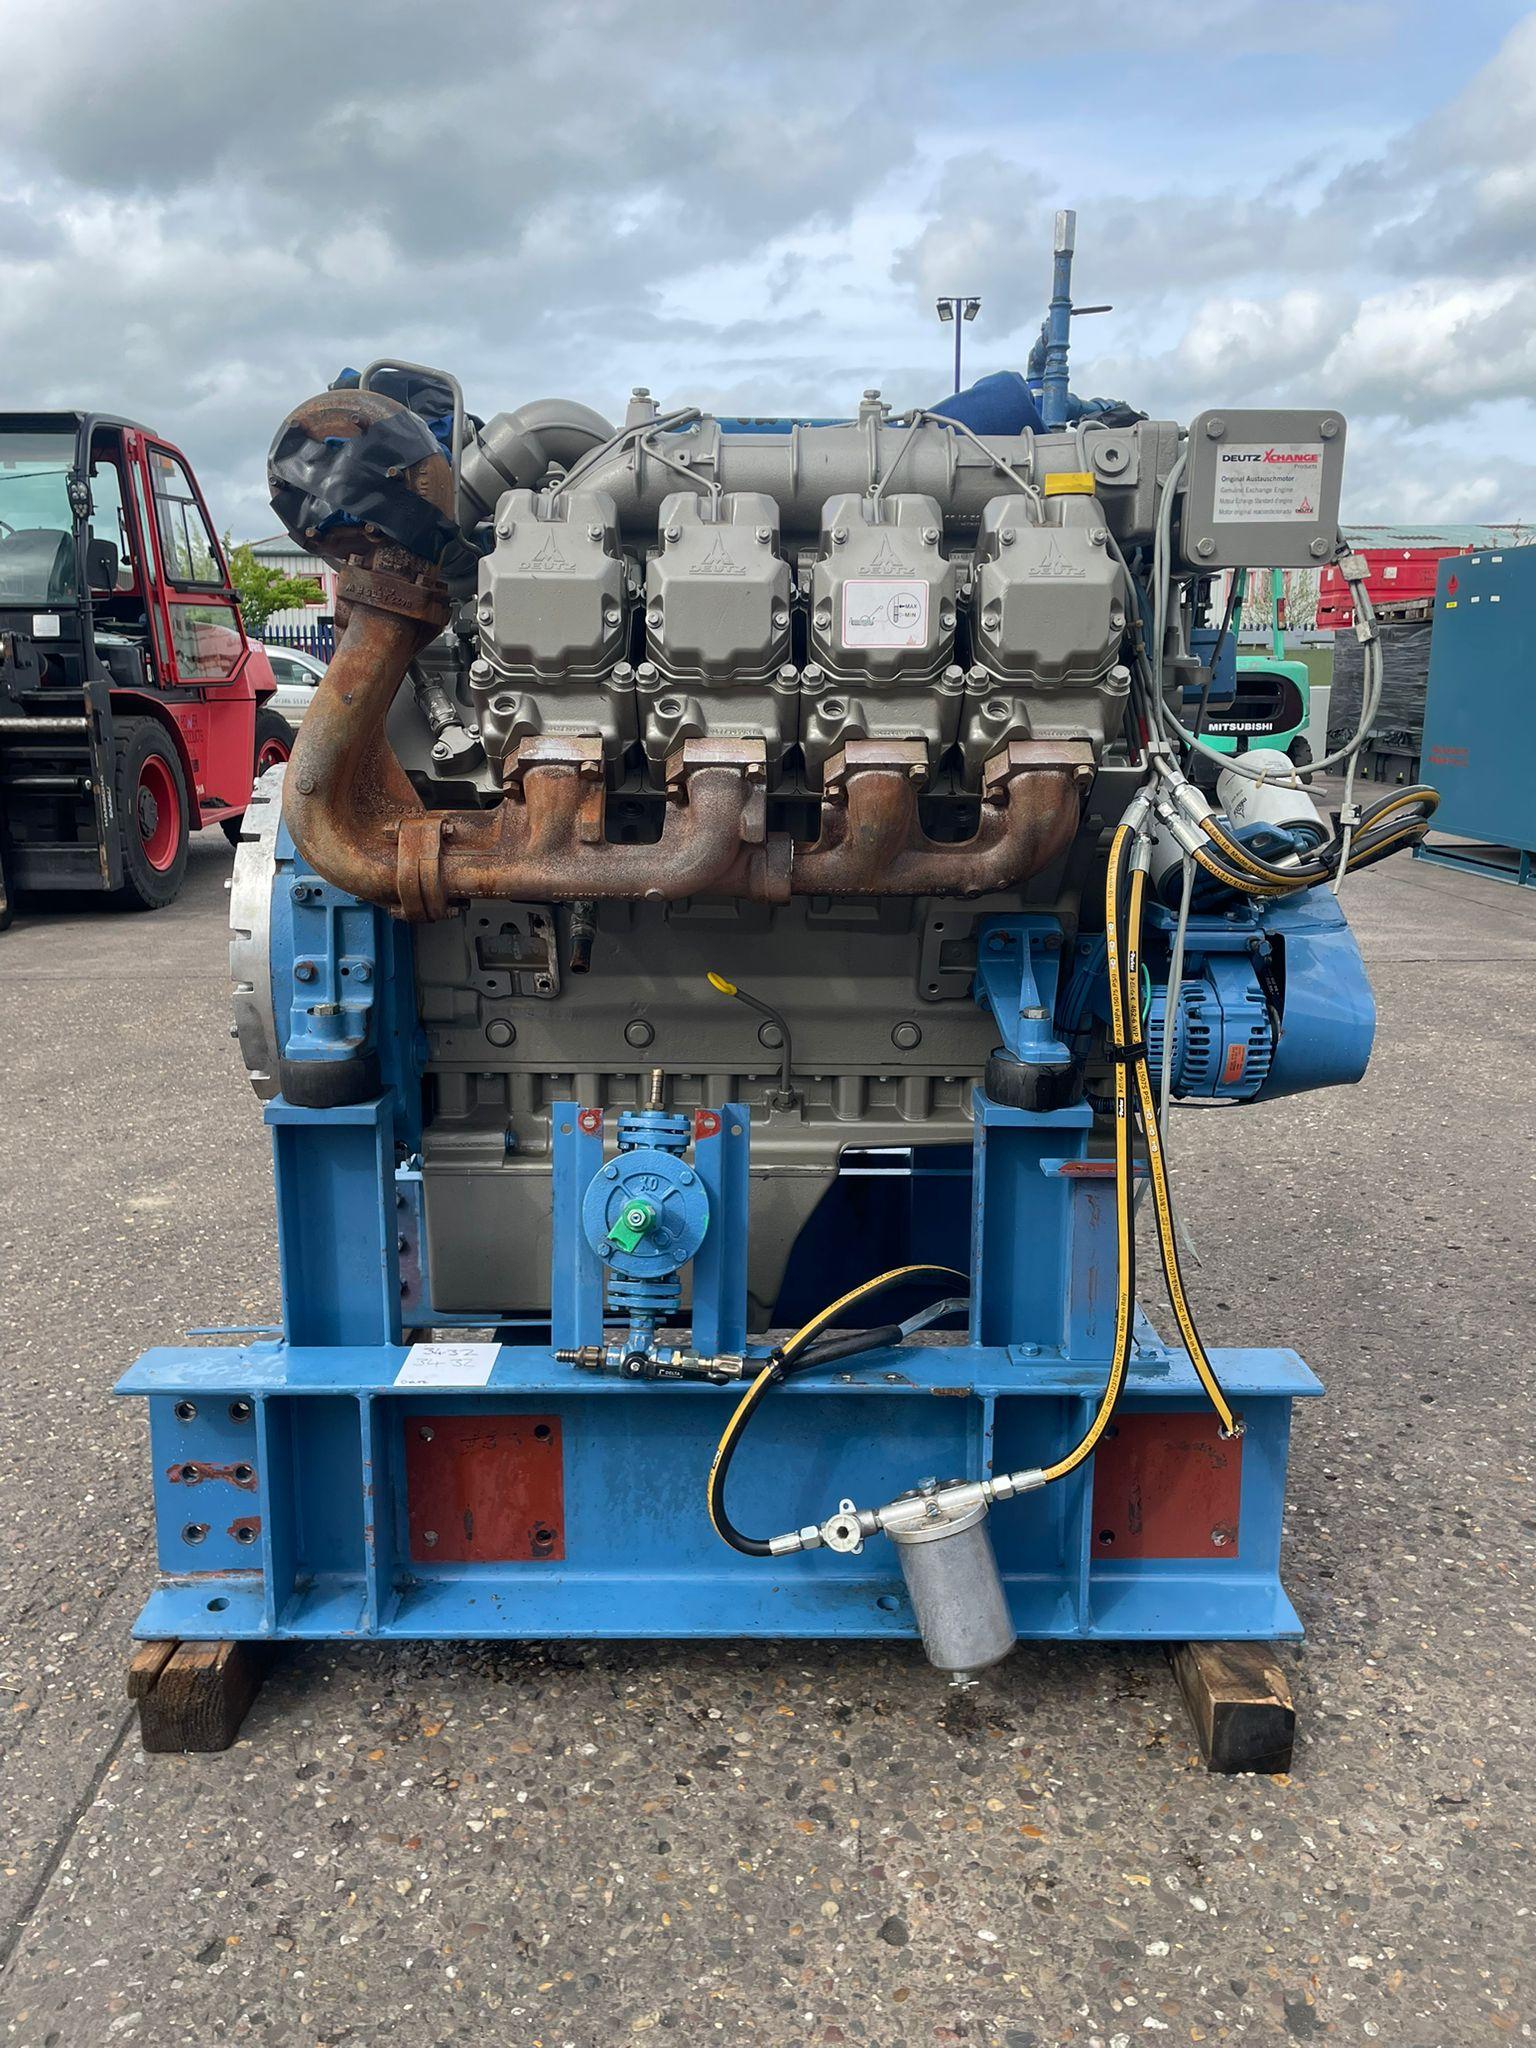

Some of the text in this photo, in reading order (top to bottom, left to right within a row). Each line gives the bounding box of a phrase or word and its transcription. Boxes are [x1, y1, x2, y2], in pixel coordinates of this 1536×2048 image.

[1222, 448, 1319, 463] DEUTZ XCHANGE
[1221, 475, 1245, 483] Original
[519, 562, 576, 570] DEUTZ
[689, 565, 746, 573] DEUTZ
[1028, 568, 1086, 576] DEUTZ
[1208, 722, 1273, 732] MITSUBISHI
[1184, 1323, 1193, 1340] Made
